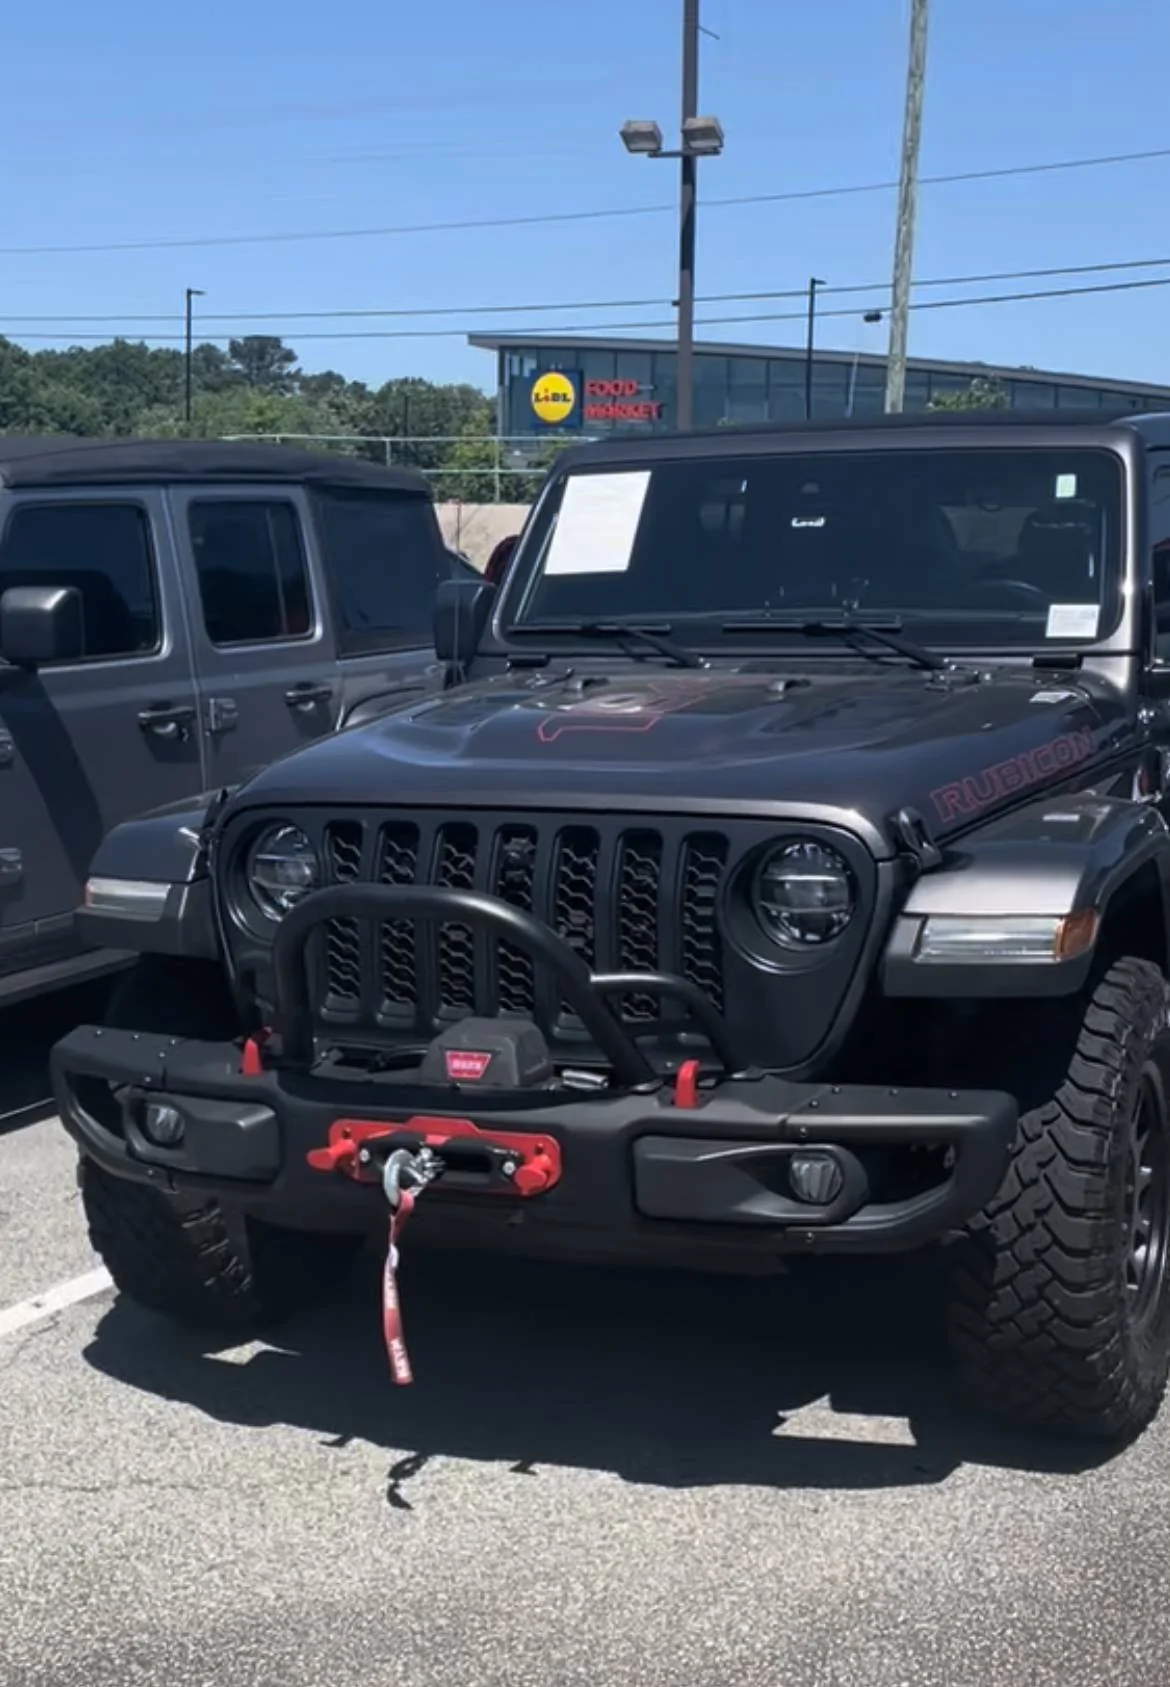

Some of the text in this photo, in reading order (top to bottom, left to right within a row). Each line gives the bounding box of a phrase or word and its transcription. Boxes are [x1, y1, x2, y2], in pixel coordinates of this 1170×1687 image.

[587, 380, 638, 397] FOOD
[587, 402, 661, 419] MARKET
[930, 726, 1097, 822] RUBICON
